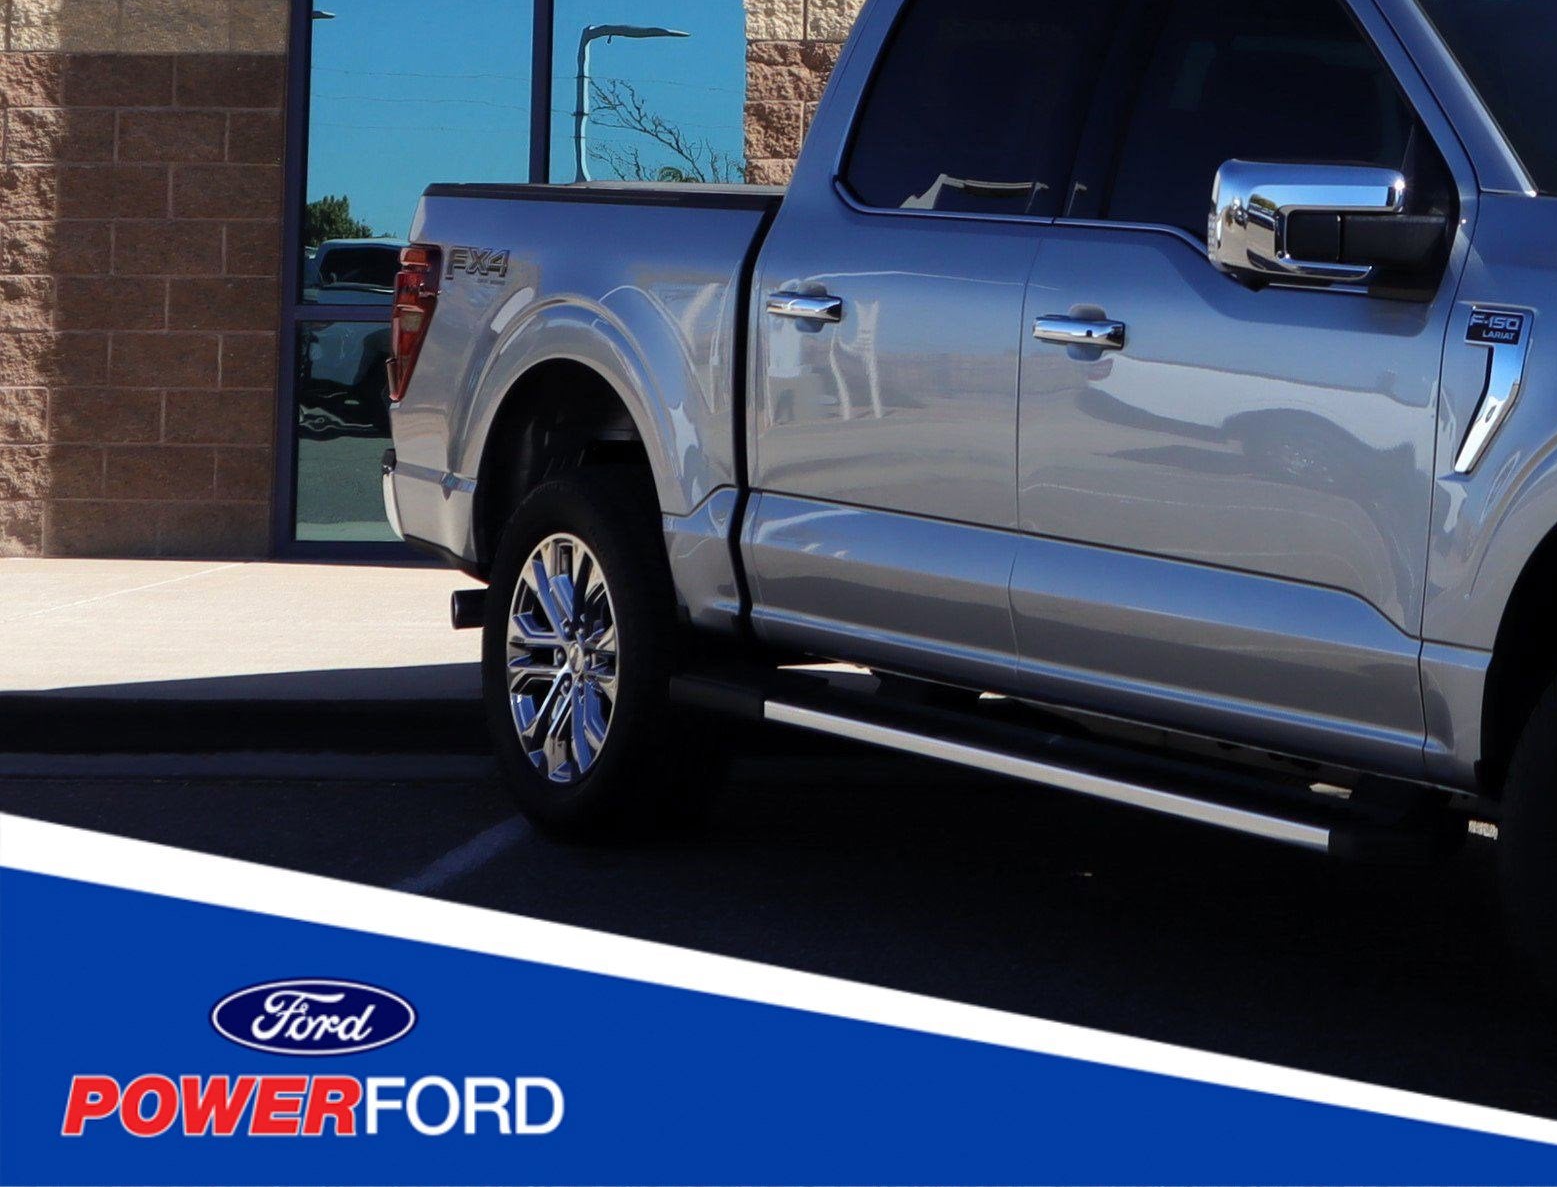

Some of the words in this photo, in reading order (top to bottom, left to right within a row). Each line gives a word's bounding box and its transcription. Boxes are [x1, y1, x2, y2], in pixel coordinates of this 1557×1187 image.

[445, 246, 511, 280] FX4
[1470, 313, 1519, 330] F-150
[1482, 330, 1515, 340] LARIAT
